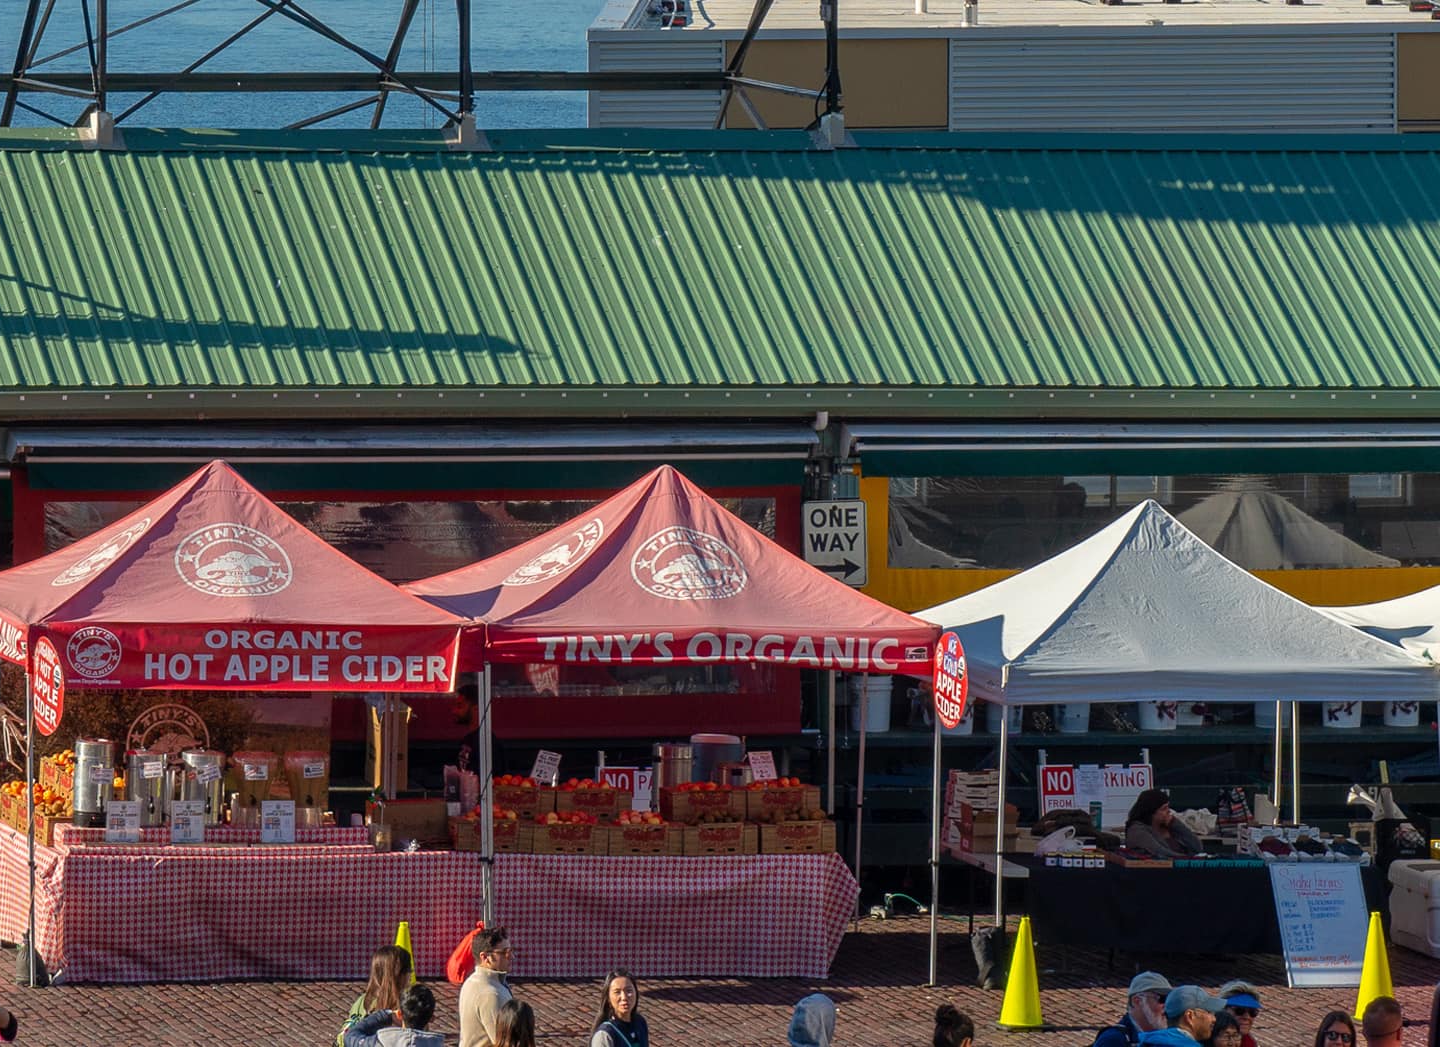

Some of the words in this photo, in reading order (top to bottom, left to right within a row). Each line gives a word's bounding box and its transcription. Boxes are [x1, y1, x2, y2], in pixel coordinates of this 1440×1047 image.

[810, 508, 858, 528] ONE
[191, 526, 270, 548] TINY'S
[809, 532, 860, 552] WAY
[194, 579, 278, 594] ORGANIC
[76, 629, 112, 640] TINY'S
[204, 629, 363, 650] ORGANIC
[537, 632, 675, 663] TINY'S
[686, 631, 899, 670] ORGANIC
[39, 659, 51, 680] HOT
[73, 662, 114, 677] ORGANIC
[144, 653, 214, 681] HOT
[223, 654, 330, 682] APPLE
[342, 655, 449, 683] CIDER
[34, 675, 59, 708] APPLE
[936, 670, 962, 704] APPLE
[33, 694, 58, 728] CIDER
[935, 691, 961, 720] CIDER
[140, 708, 198, 727] TINY'S
[604, 772, 630, 791] NO
[1046, 770, 1071, 792] NO
[1104, 770, 1145, 788] RKING
[1048, 799, 1072, 808] FROM
